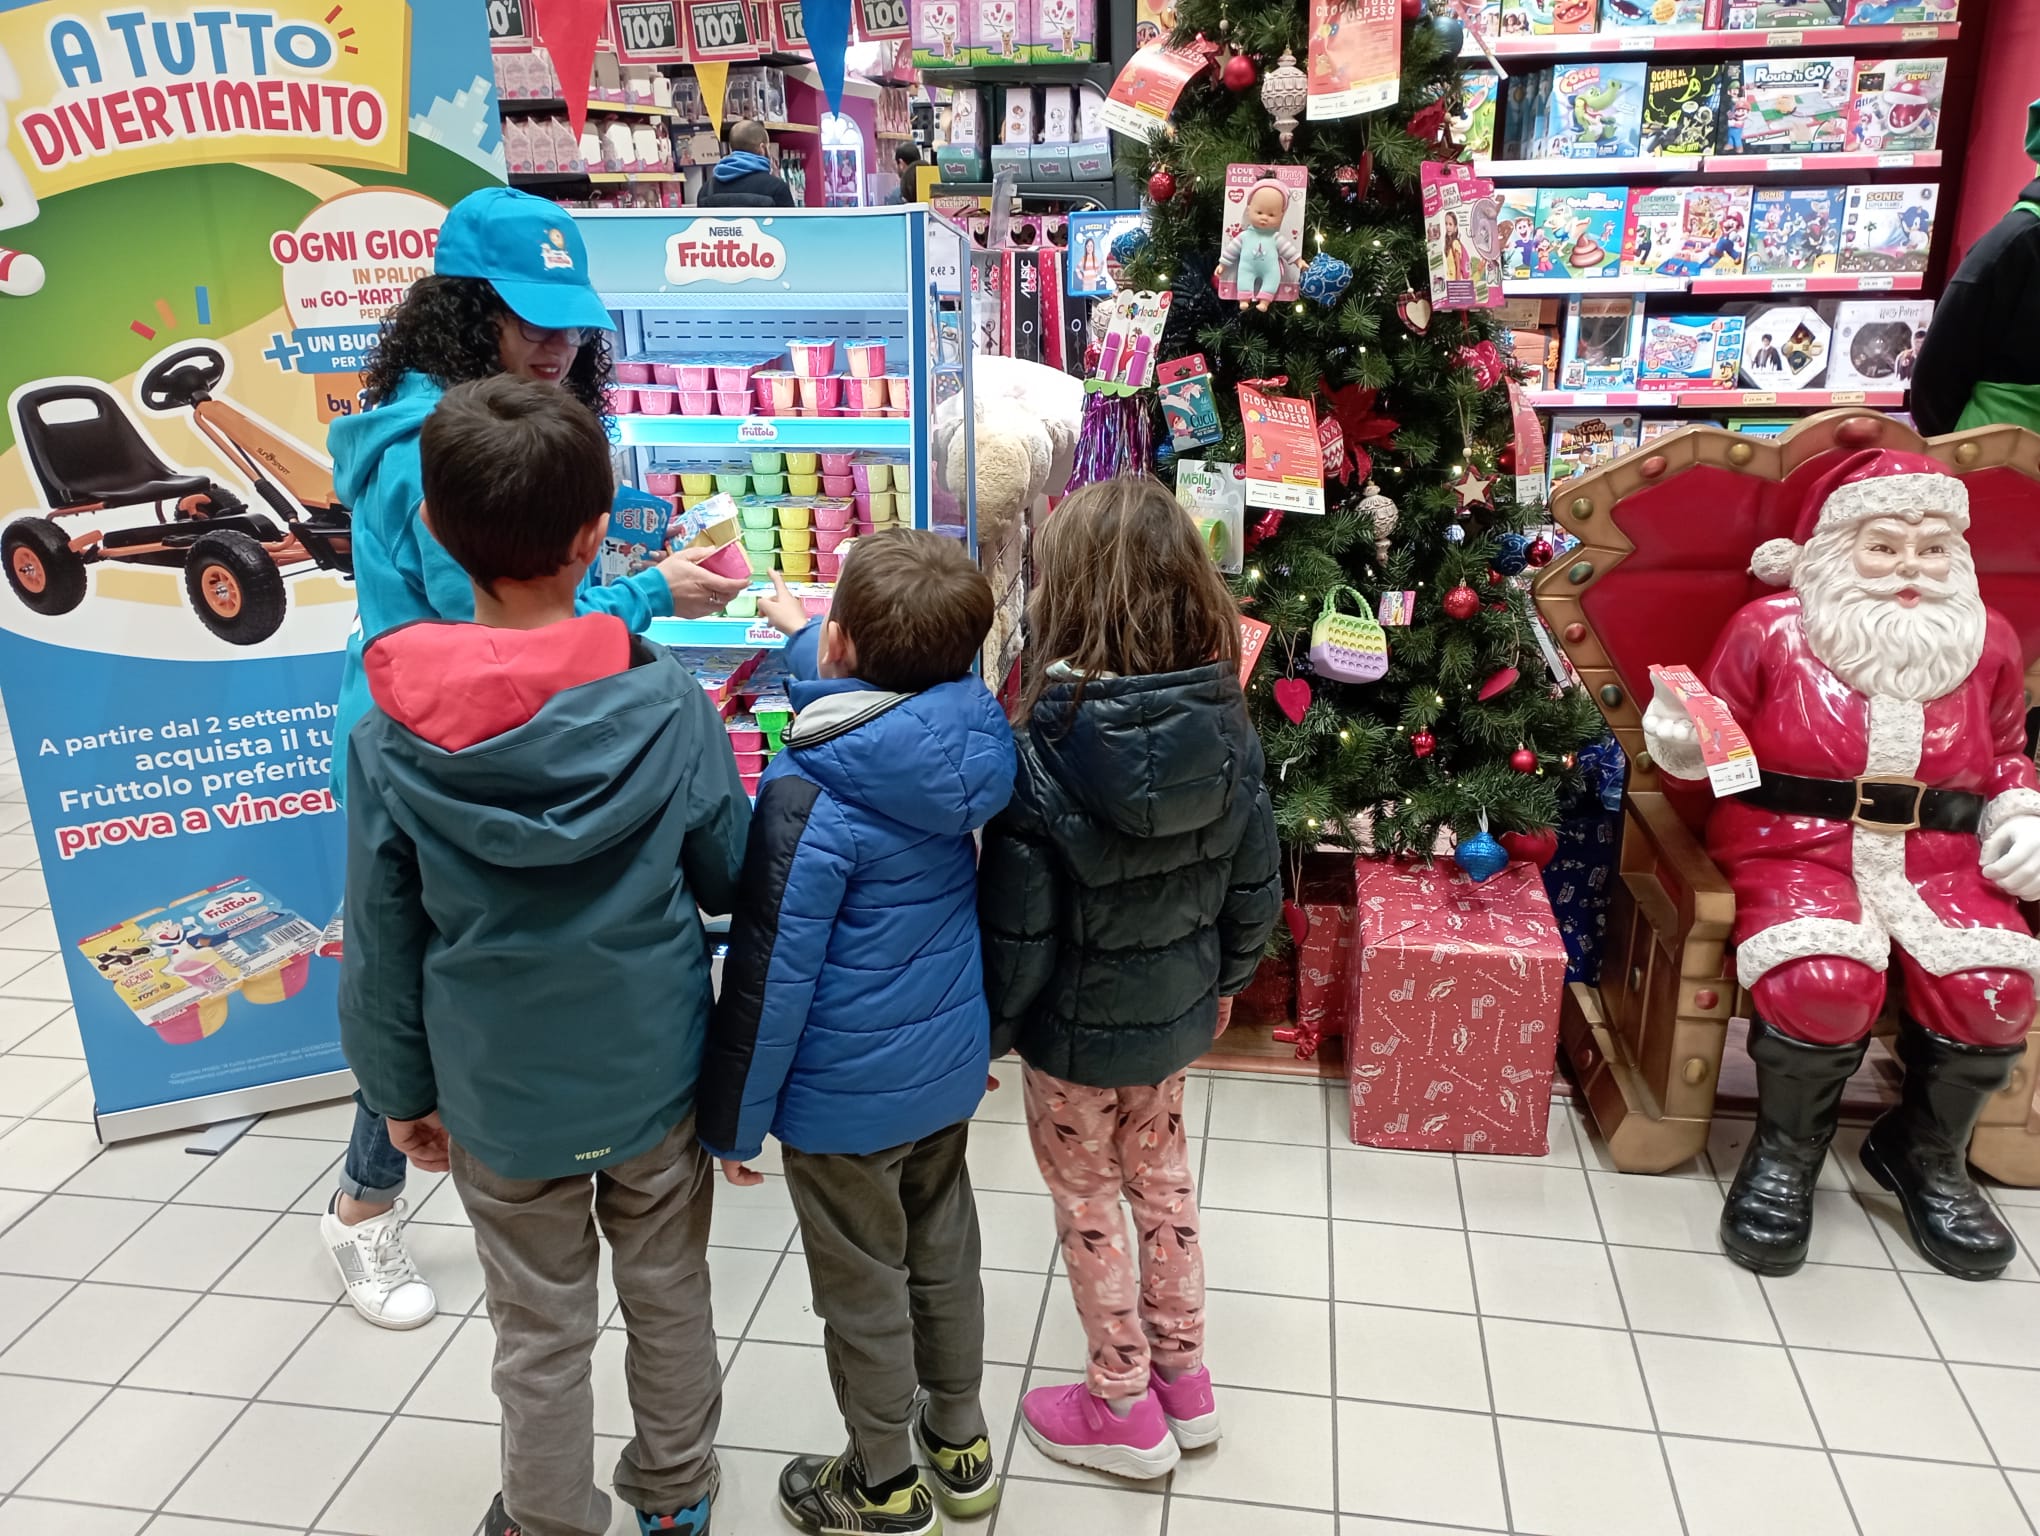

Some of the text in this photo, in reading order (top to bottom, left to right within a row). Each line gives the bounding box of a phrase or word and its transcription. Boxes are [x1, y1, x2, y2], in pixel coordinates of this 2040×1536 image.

[50, 11, 332, 88] A TUTTO
[1756, 67, 1793, 82] Route
[1804, 64, 1834, 80] GO!
[21, 79, 383, 167] DIVERTIMENTO
[1867, 191, 1904, 201] SONIC
[709, 226, 743, 237] Nestlé
[273, 231, 357, 264] OGNI
[678, 239, 775, 268] Frùttolo
[352, 268, 371, 285] IN
[1020, 259, 1031, 298] MUSIC
[301, 288, 404, 309] UN GO-KART
[360, 308, 380, 319] PER
[307, 335, 336, 353] UN
[331, 356, 356, 369] PER
[326, 394, 352, 416] by
[1243, 392, 1307, 414] GIOCATTOLO
[1265, 408, 1310, 424] SOSPESO
[39, 738, 60, 757] A
[65, 725, 154, 757] partire
[160, 718, 200, 739] dal
[205, 717, 222, 734] 2
[135, 736, 273, 771] acquista
[280, 728, 300, 751] il
[59, 775, 193, 812] Frùttolo
[58, 814, 174, 857] prova
[184, 810, 208, 830] a
